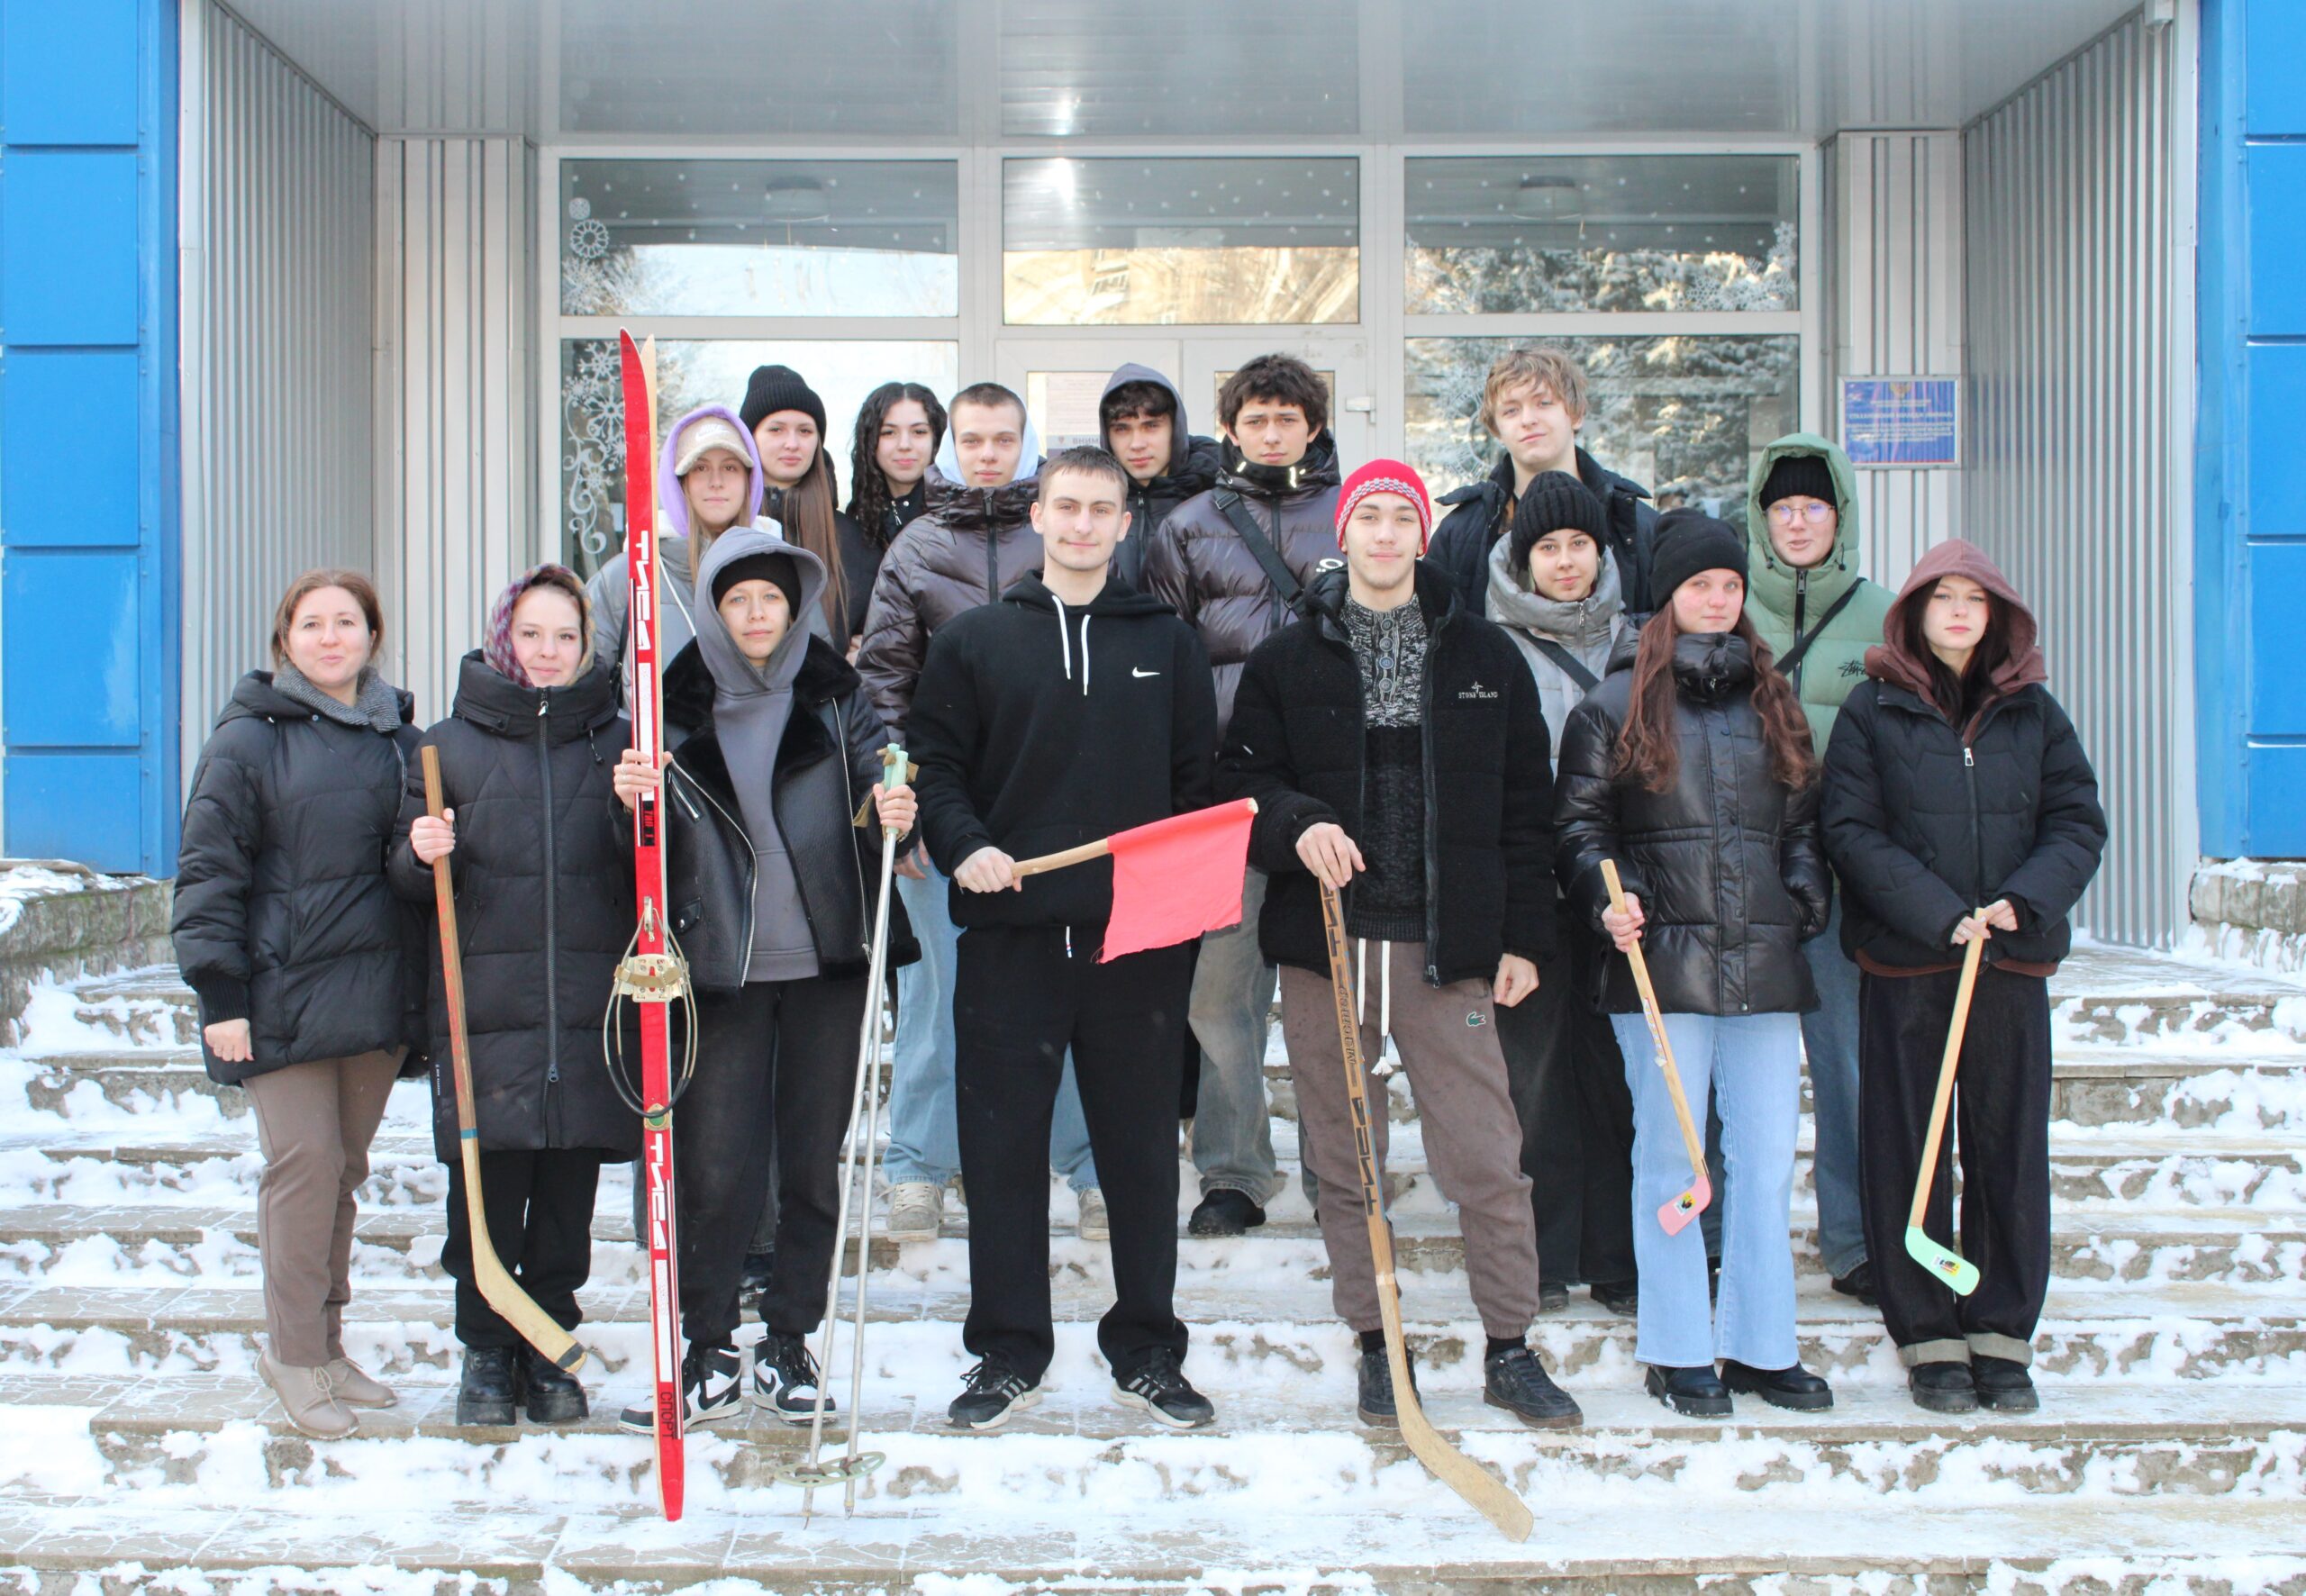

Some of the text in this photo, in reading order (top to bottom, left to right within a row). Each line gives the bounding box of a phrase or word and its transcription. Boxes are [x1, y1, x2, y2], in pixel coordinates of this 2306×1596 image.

[636, 530, 650, 650] ТИСА
[1478, 691, 1499, 699] ISLAND
[1322, 881, 1340, 957] ТИ
[650, 1133, 667, 1249] ТИСА
[1351, 1097, 1376, 1216] ТИСА
[660, 1392, 674, 1439] СПОРТ
